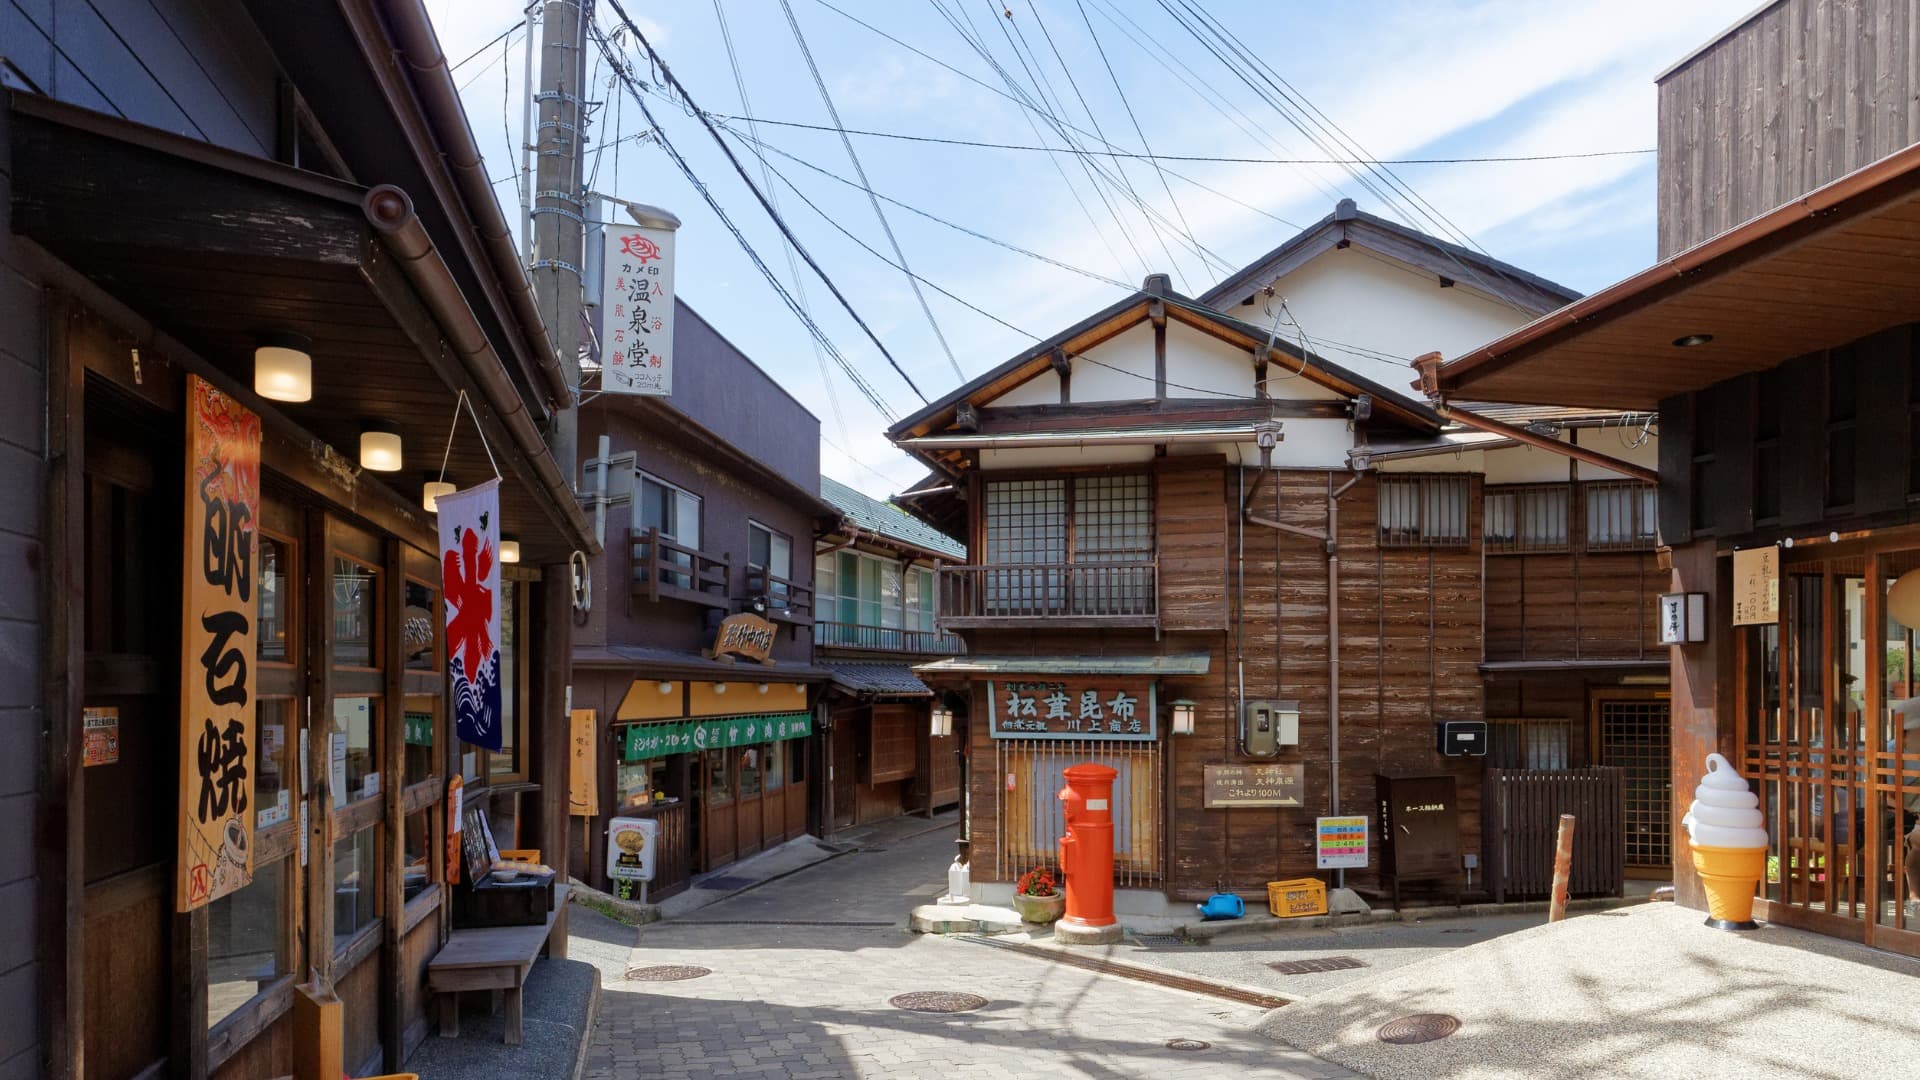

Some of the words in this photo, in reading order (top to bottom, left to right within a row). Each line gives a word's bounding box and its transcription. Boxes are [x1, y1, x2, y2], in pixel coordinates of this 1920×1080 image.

[622, 263, 659, 276] カメ印
[627, 278, 652, 368] 温泉堂
[649, 281, 663, 369] 入浴剤
[197, 459, 252, 825] 明石焼
[443, 527, 494, 685] 氷
[1006, 690, 1138, 722] 松茸昆布
[1066, 718, 1142, 733] 川上商店
